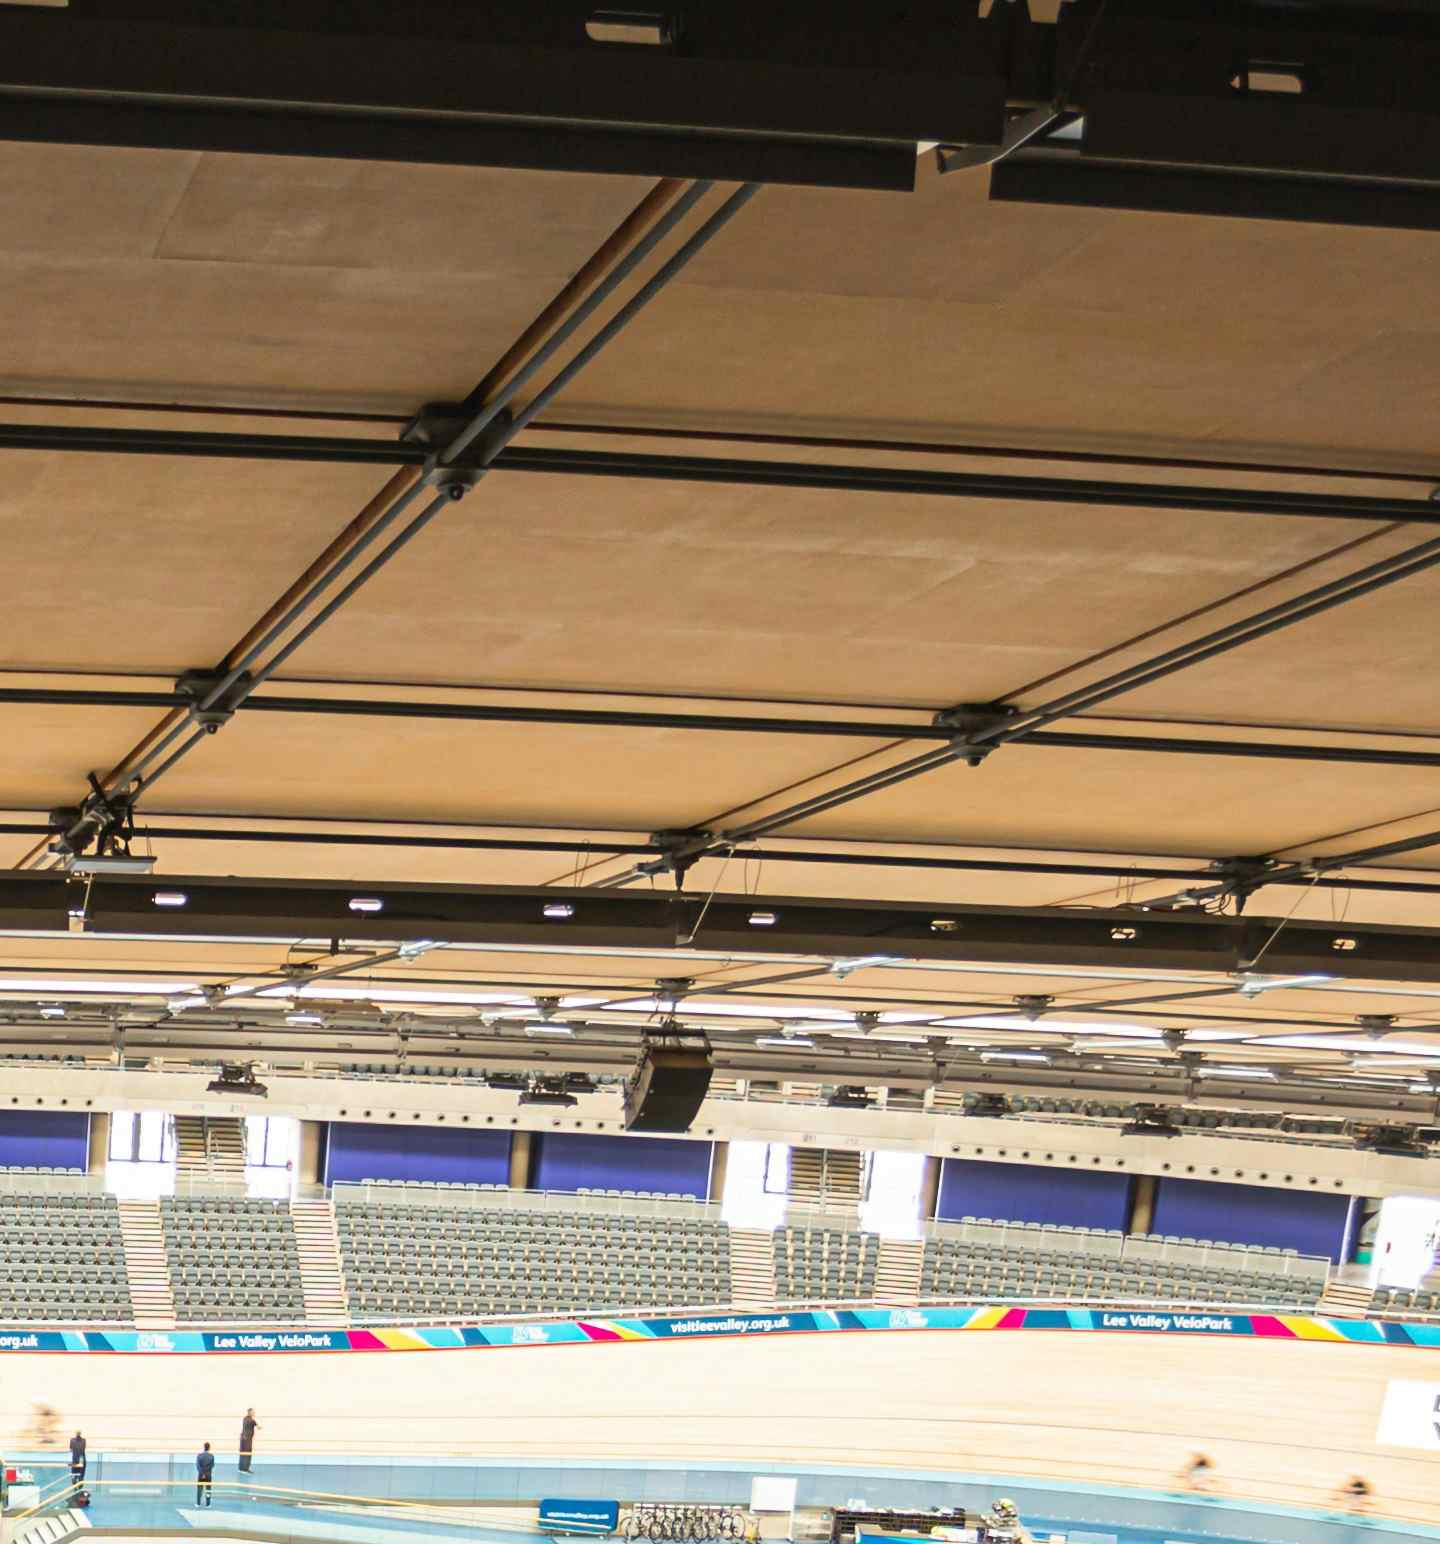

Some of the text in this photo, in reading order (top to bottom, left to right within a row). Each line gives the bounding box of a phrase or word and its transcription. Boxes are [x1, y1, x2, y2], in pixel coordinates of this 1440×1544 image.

[670, 1317, 790, 1334] visitleevalley.org.uk
[1102, 1313, 1233, 1331] Lee Valley VeloPark
[214, 1334, 332, 1350] Lee Valley VeloPark
